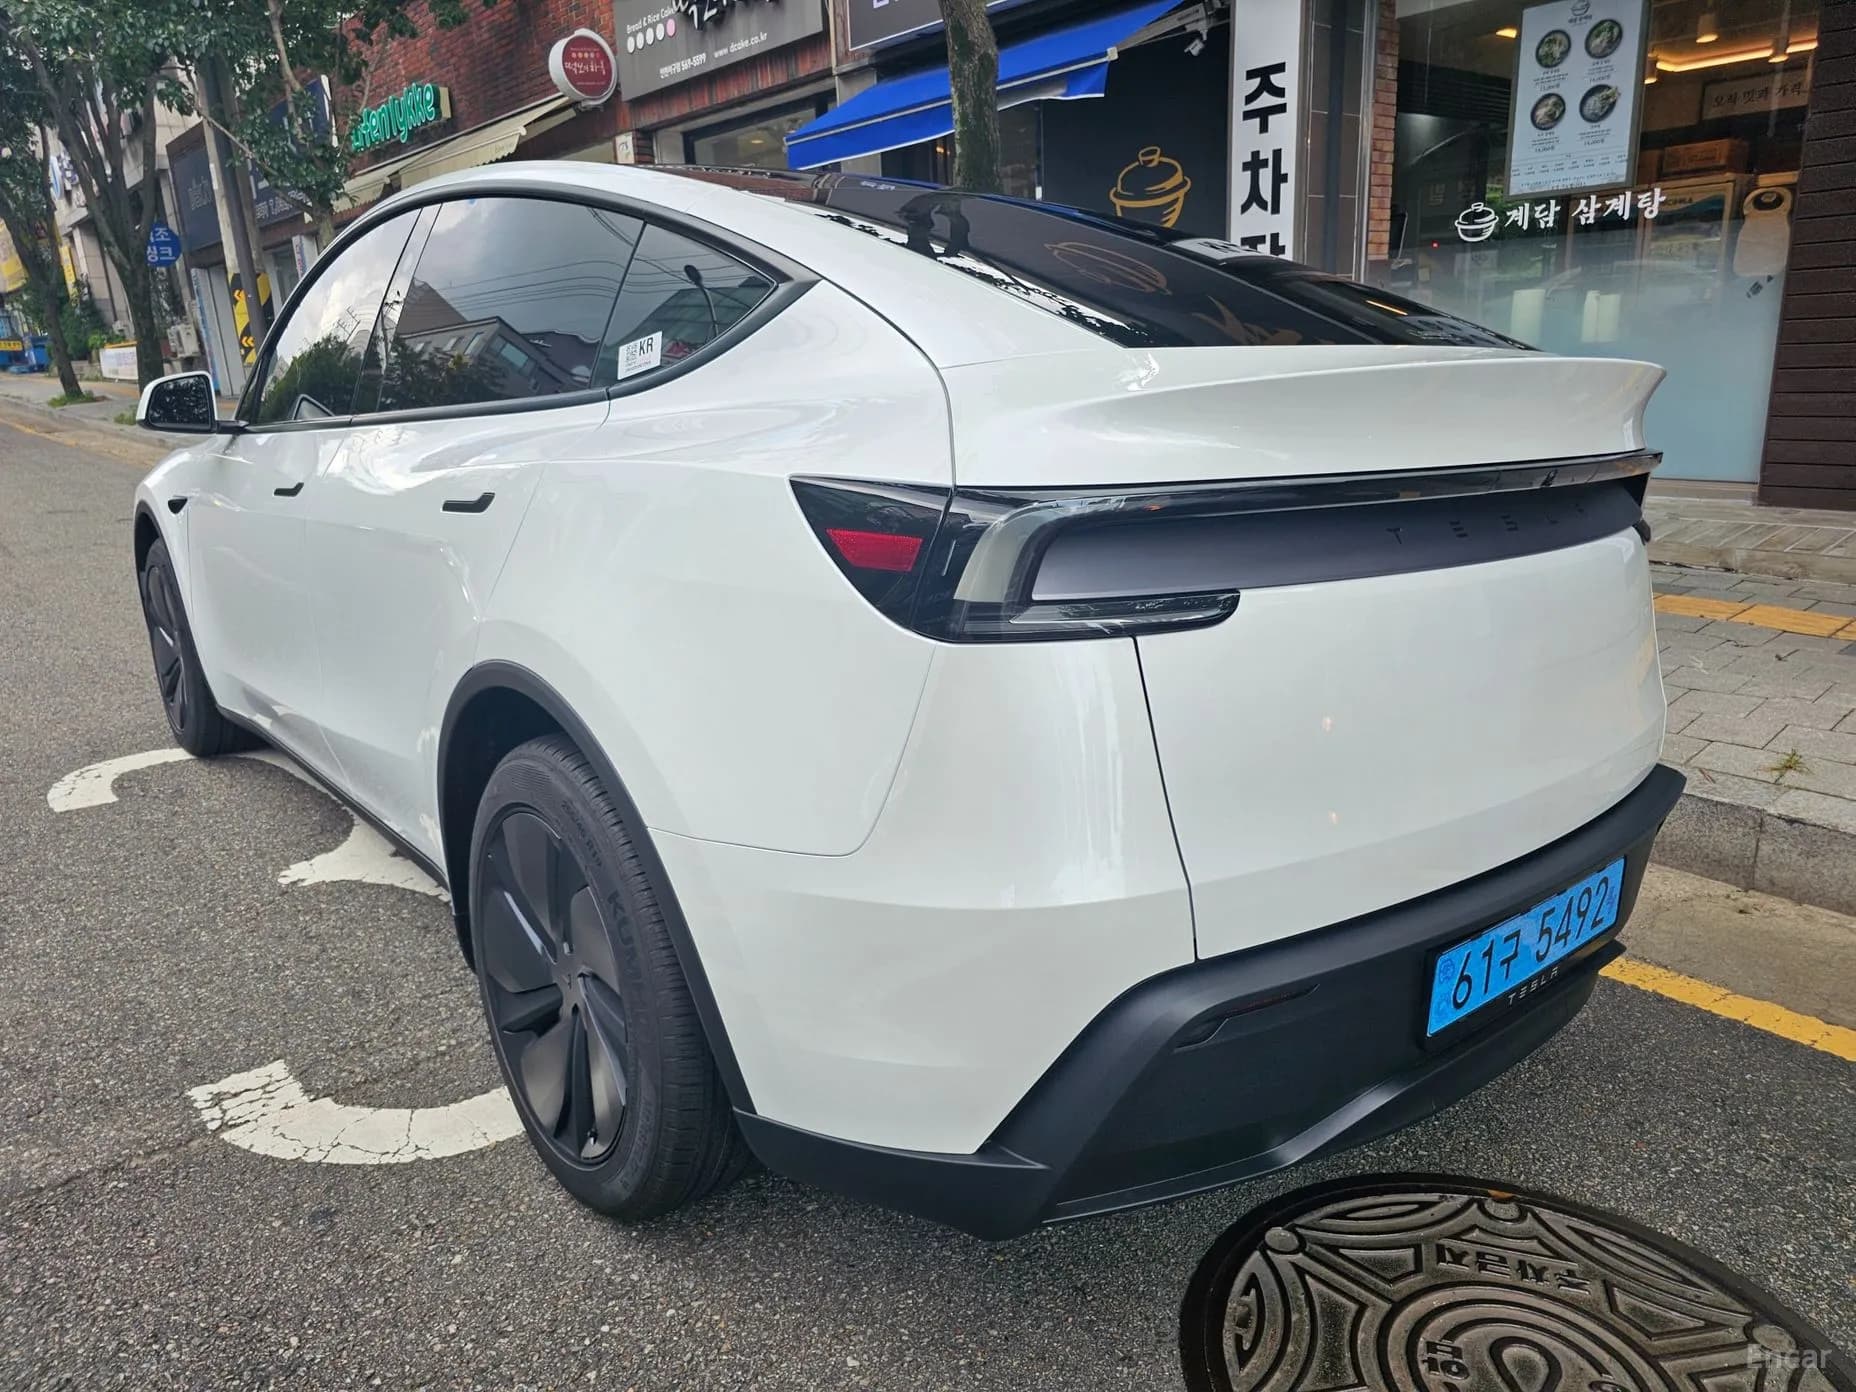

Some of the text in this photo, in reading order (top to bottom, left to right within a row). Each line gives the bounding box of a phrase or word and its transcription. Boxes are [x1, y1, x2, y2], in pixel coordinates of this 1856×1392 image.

[1504, 187, 1666, 231] 계담 삼계탕
[639, 337, 654, 356] KR
[1452, 875, 1610, 1010] 61구 5492
[1507, 965, 1559, 1008] TESLA
